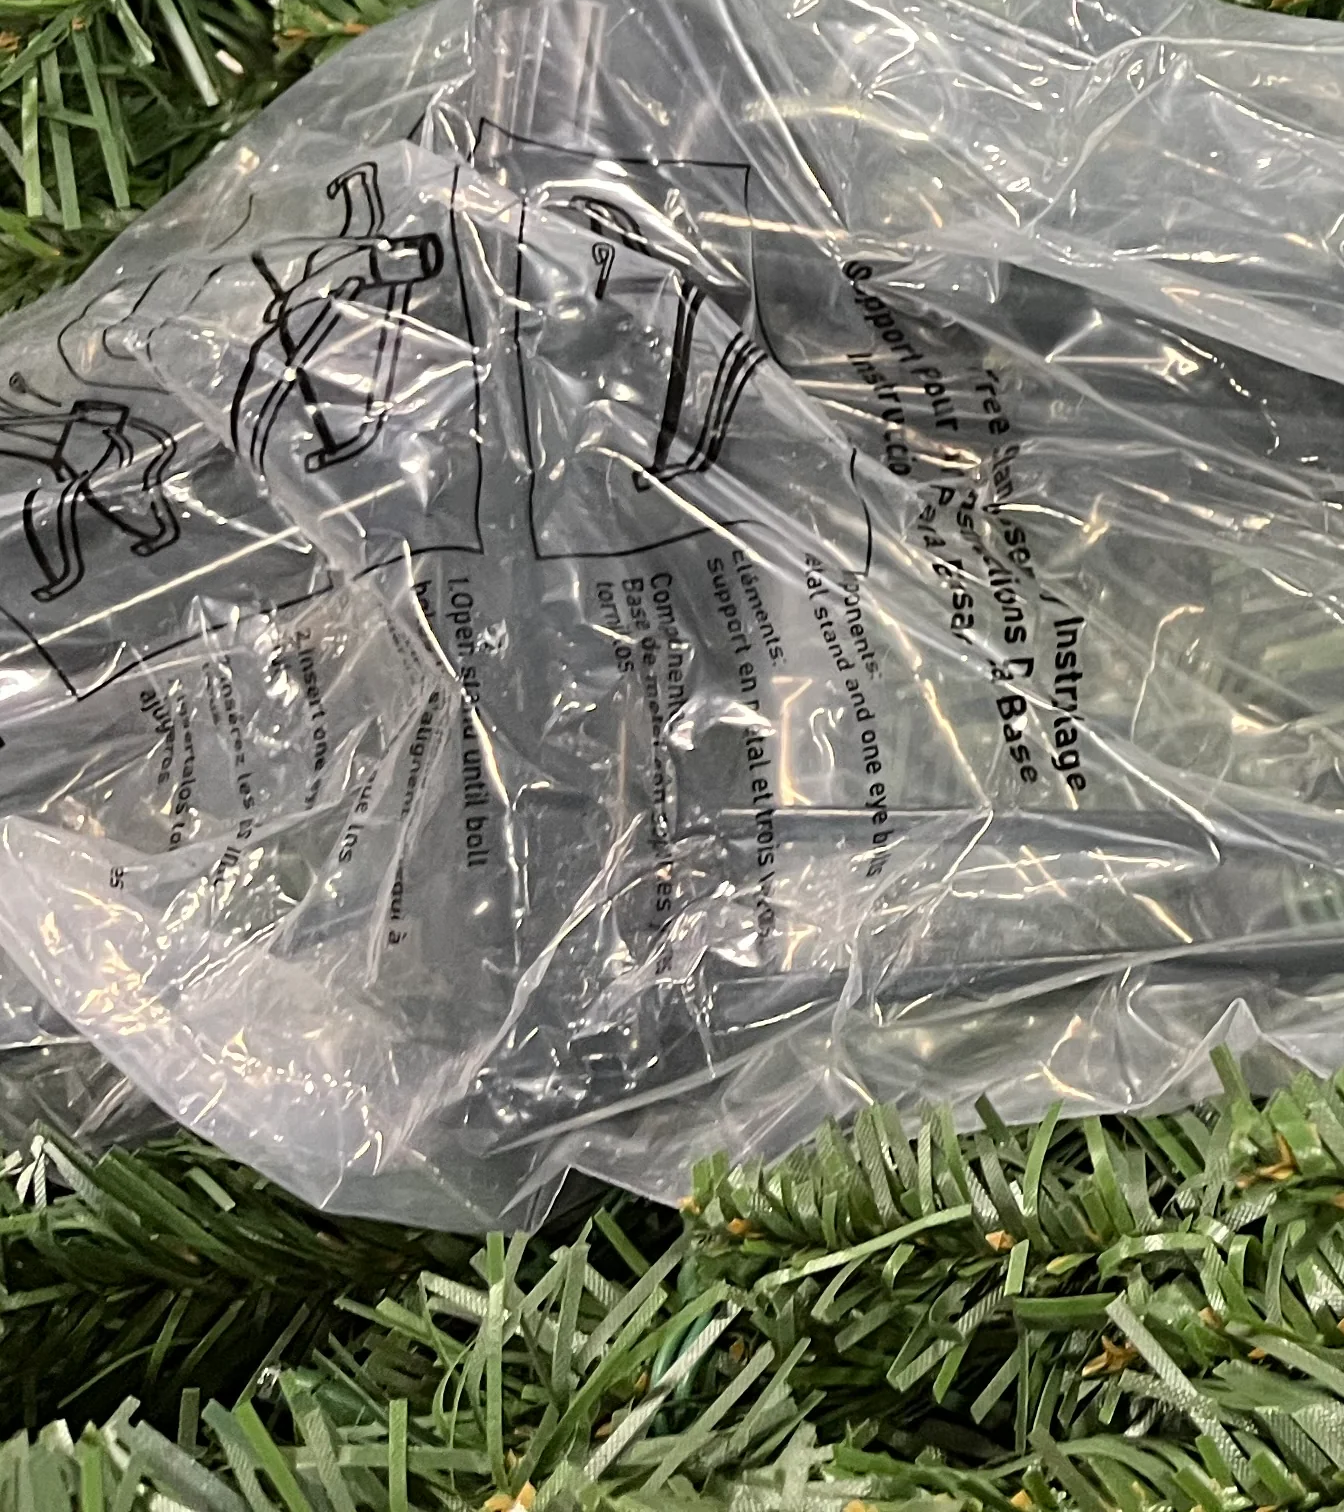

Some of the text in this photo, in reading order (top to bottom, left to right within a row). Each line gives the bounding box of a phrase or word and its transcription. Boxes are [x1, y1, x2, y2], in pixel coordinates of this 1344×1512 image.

[813, 606, 855, 672] stand
[706, 557, 752, 655] Support
[738, 662, 760, 691] en
[751, 778, 774, 803] et
[844, 678, 875, 722] and
[861, 729, 883, 775] one
[996, 694, 1041, 786] Base
[462, 748, 488, 807] until
[864, 782, 889, 825] eye
[465, 815, 490, 868] bolt
